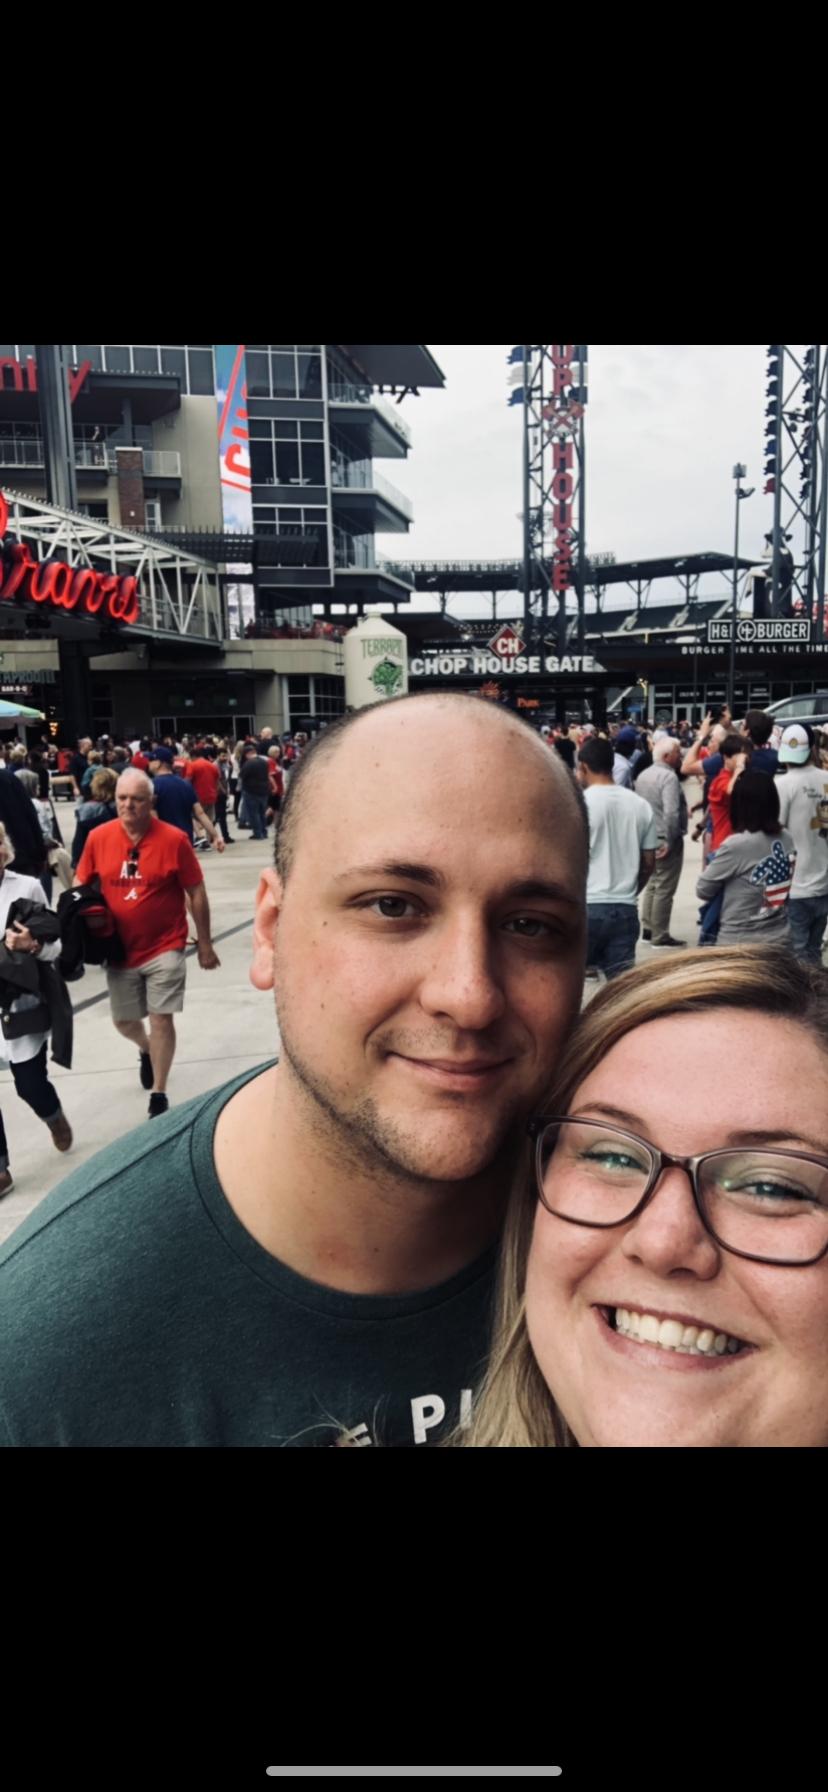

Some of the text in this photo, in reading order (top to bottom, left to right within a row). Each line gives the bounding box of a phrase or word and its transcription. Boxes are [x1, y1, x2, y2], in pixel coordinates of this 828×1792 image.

[552, 442, 573, 590] HOUSE
[757, 623, 807, 638] BURGER
[497, 638, 519, 654] CH
[682, 646, 725, 655] BURGER
[735, 645, 754, 654] IME
[759, 645, 777, 654] ALL
[783, 644, 801, 653] THE
[411, 655, 595, 675] CHOP HOUSE GATE
